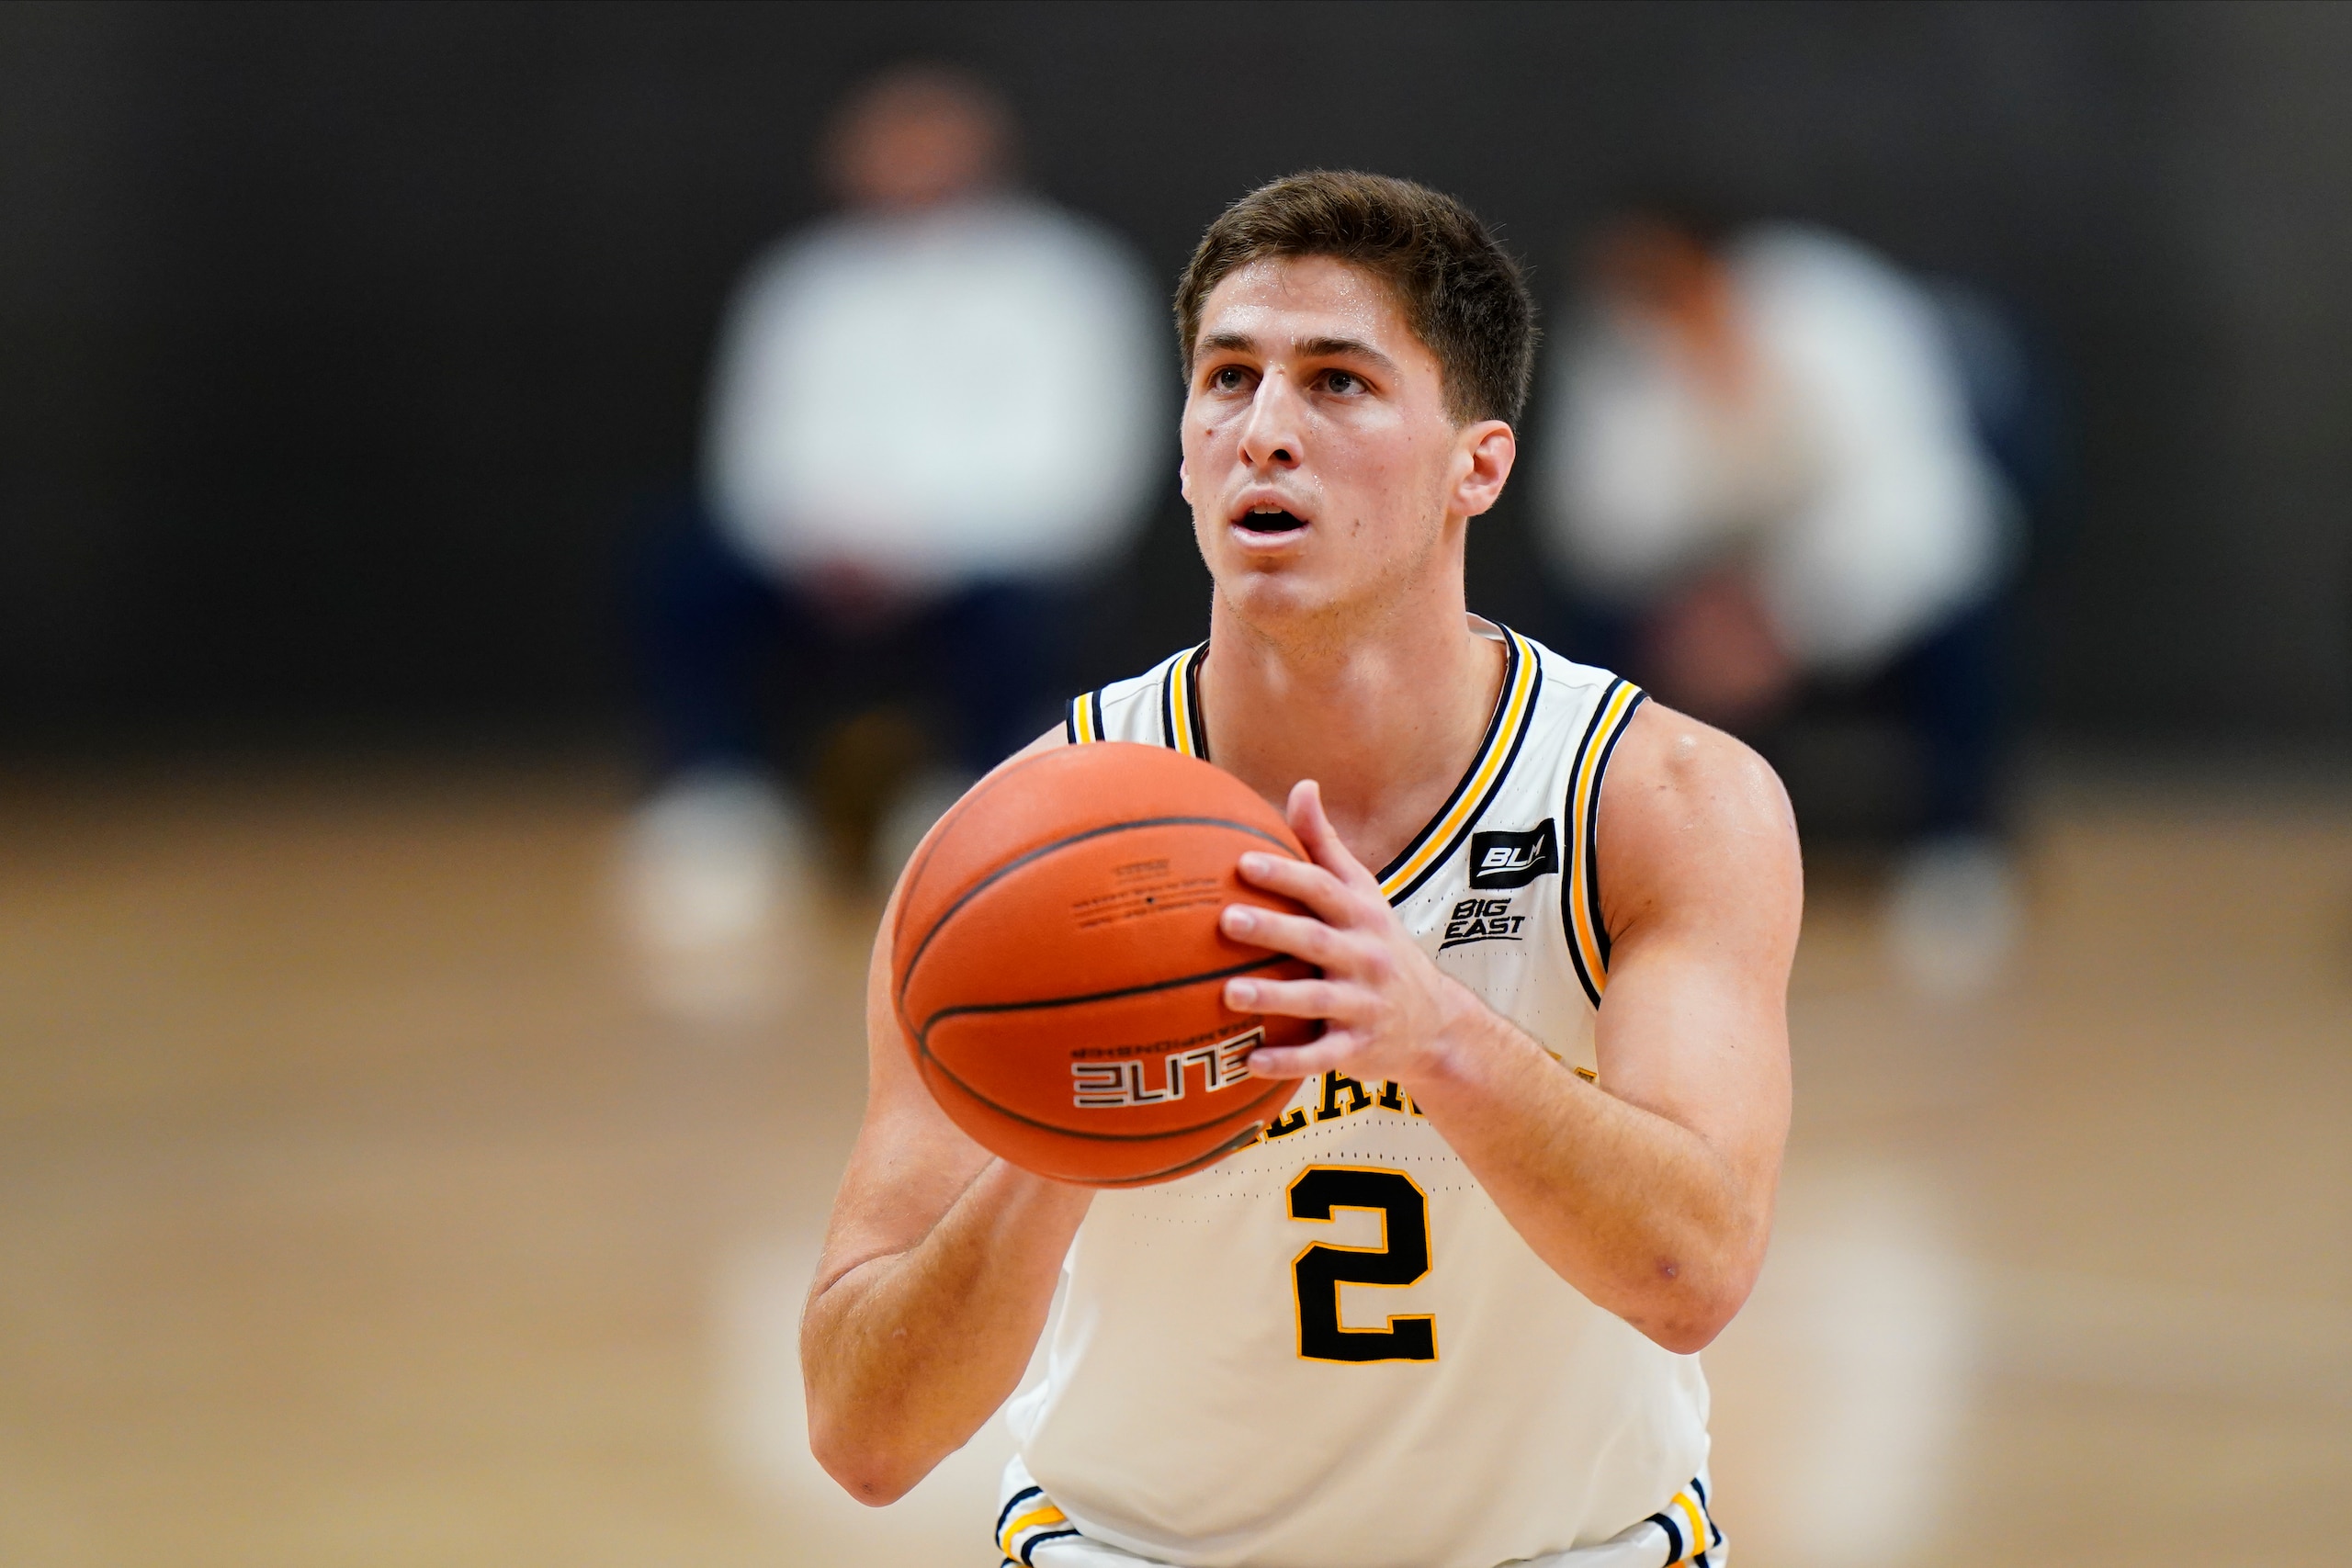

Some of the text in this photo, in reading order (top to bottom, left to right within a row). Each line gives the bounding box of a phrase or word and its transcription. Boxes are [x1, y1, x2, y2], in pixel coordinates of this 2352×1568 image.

[1480, 833, 1545, 868] BLM
[1444, 916, 1526, 940] EAST
[1451, 897, 1512, 920] BIG
[1071, 1014, 1265, 1058] CHAMPIONSHIP
[1071, 1025, 1265, 1108] ELITE
[1285, 1164, 1440, 1365] 2
